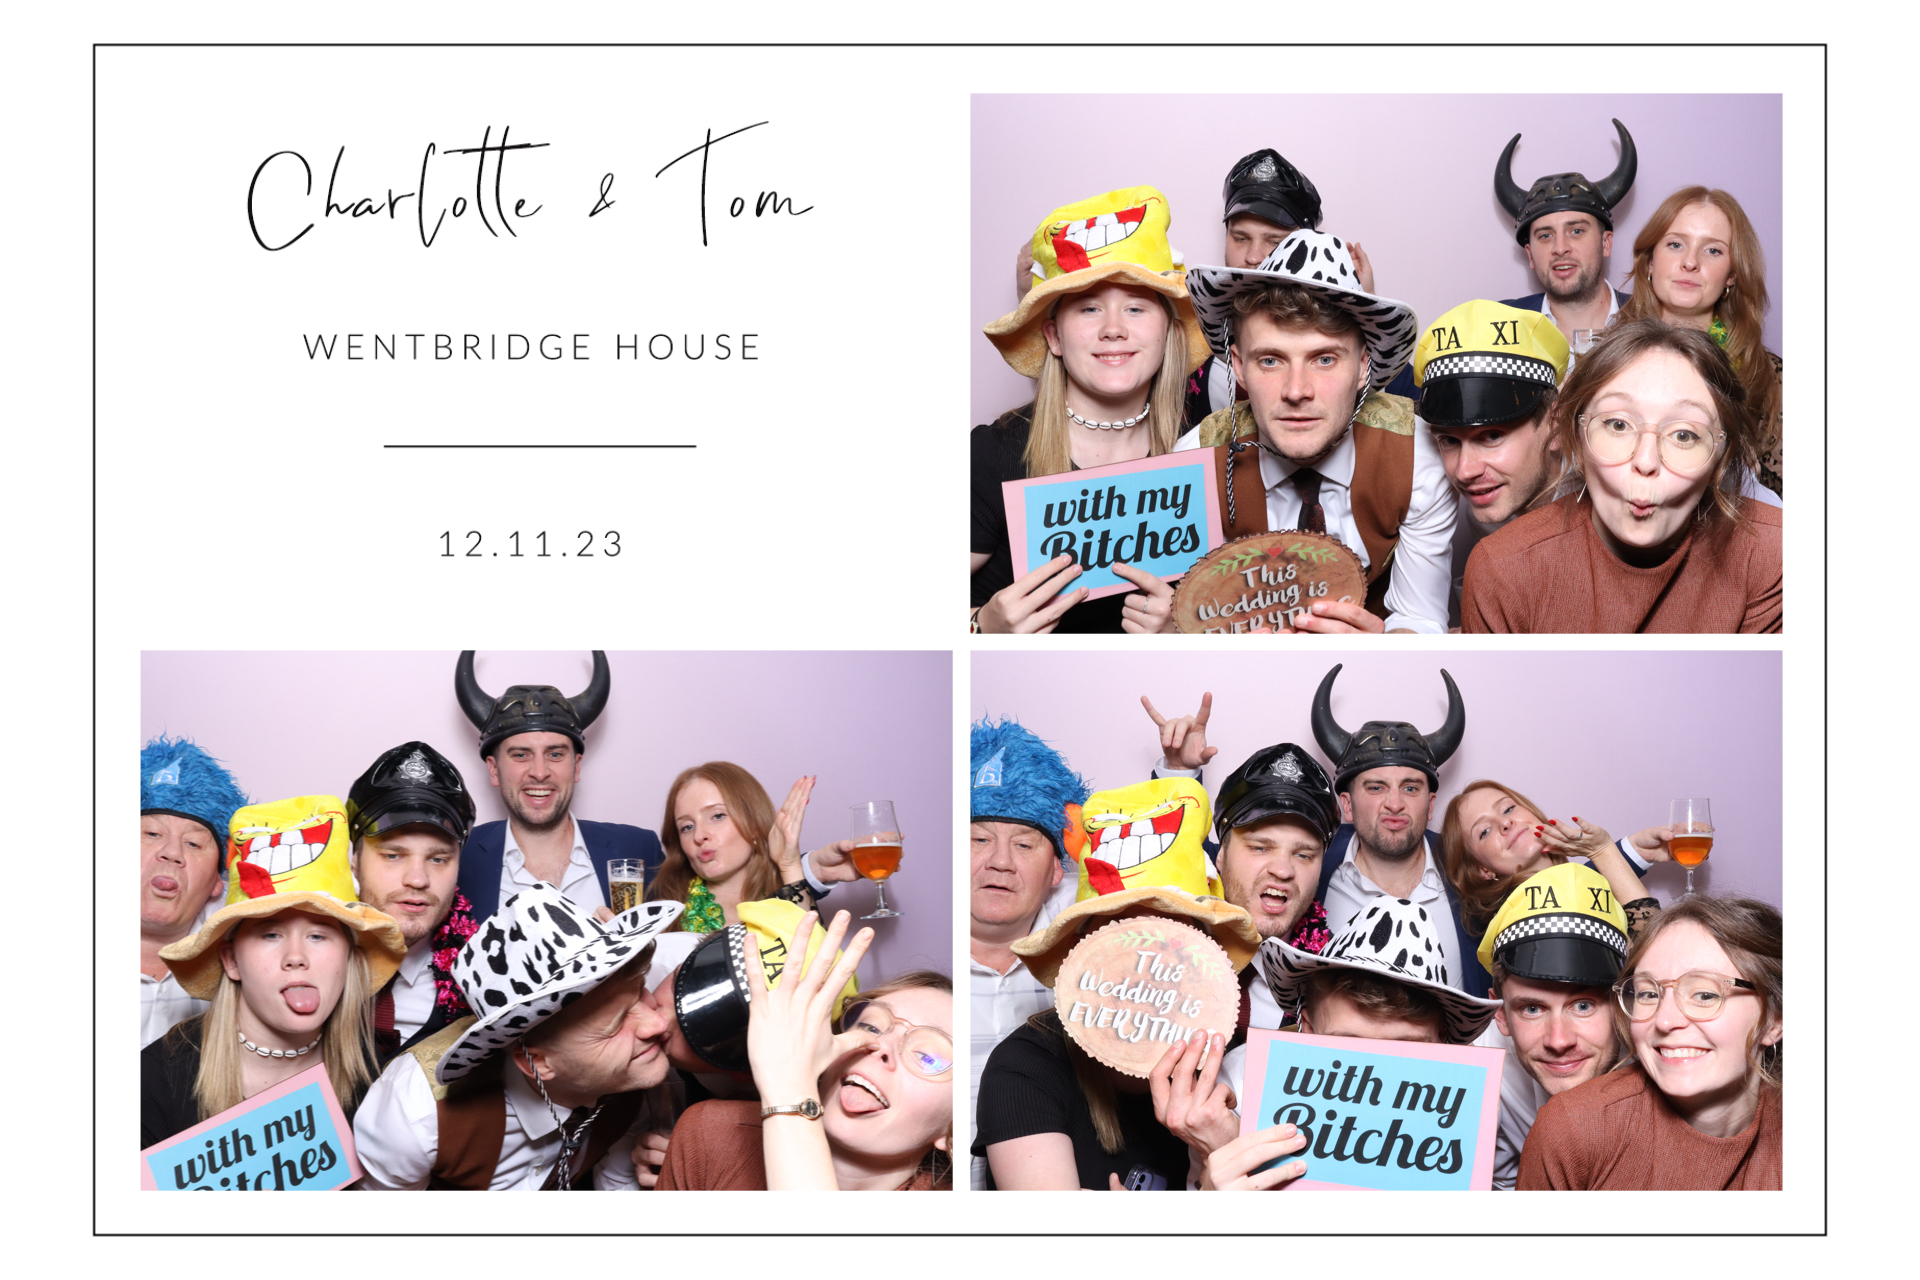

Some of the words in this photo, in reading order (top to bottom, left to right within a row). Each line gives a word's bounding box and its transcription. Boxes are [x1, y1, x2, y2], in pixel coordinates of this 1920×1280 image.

[1043, 485, 1127, 529] with
[1136, 483, 1192, 520] my
[1040, 520, 1201, 573] Bitches
[1239, 563, 1299, 588] This
[1198, 584, 1304, 622] Wedding
[1308, 581, 1331, 598] is
[1137, 950, 1188, 983] This
[1079, 968, 1180, 1015] Wedding
[1180, 994, 1205, 1019] is
[1282, 1059, 1384, 1107] with
[1391, 1080, 1468, 1130] my
[173, 1127, 257, 1190] with
[263, 1103, 317, 1150] my
[1272, 1102, 1464, 1175] Bitches
